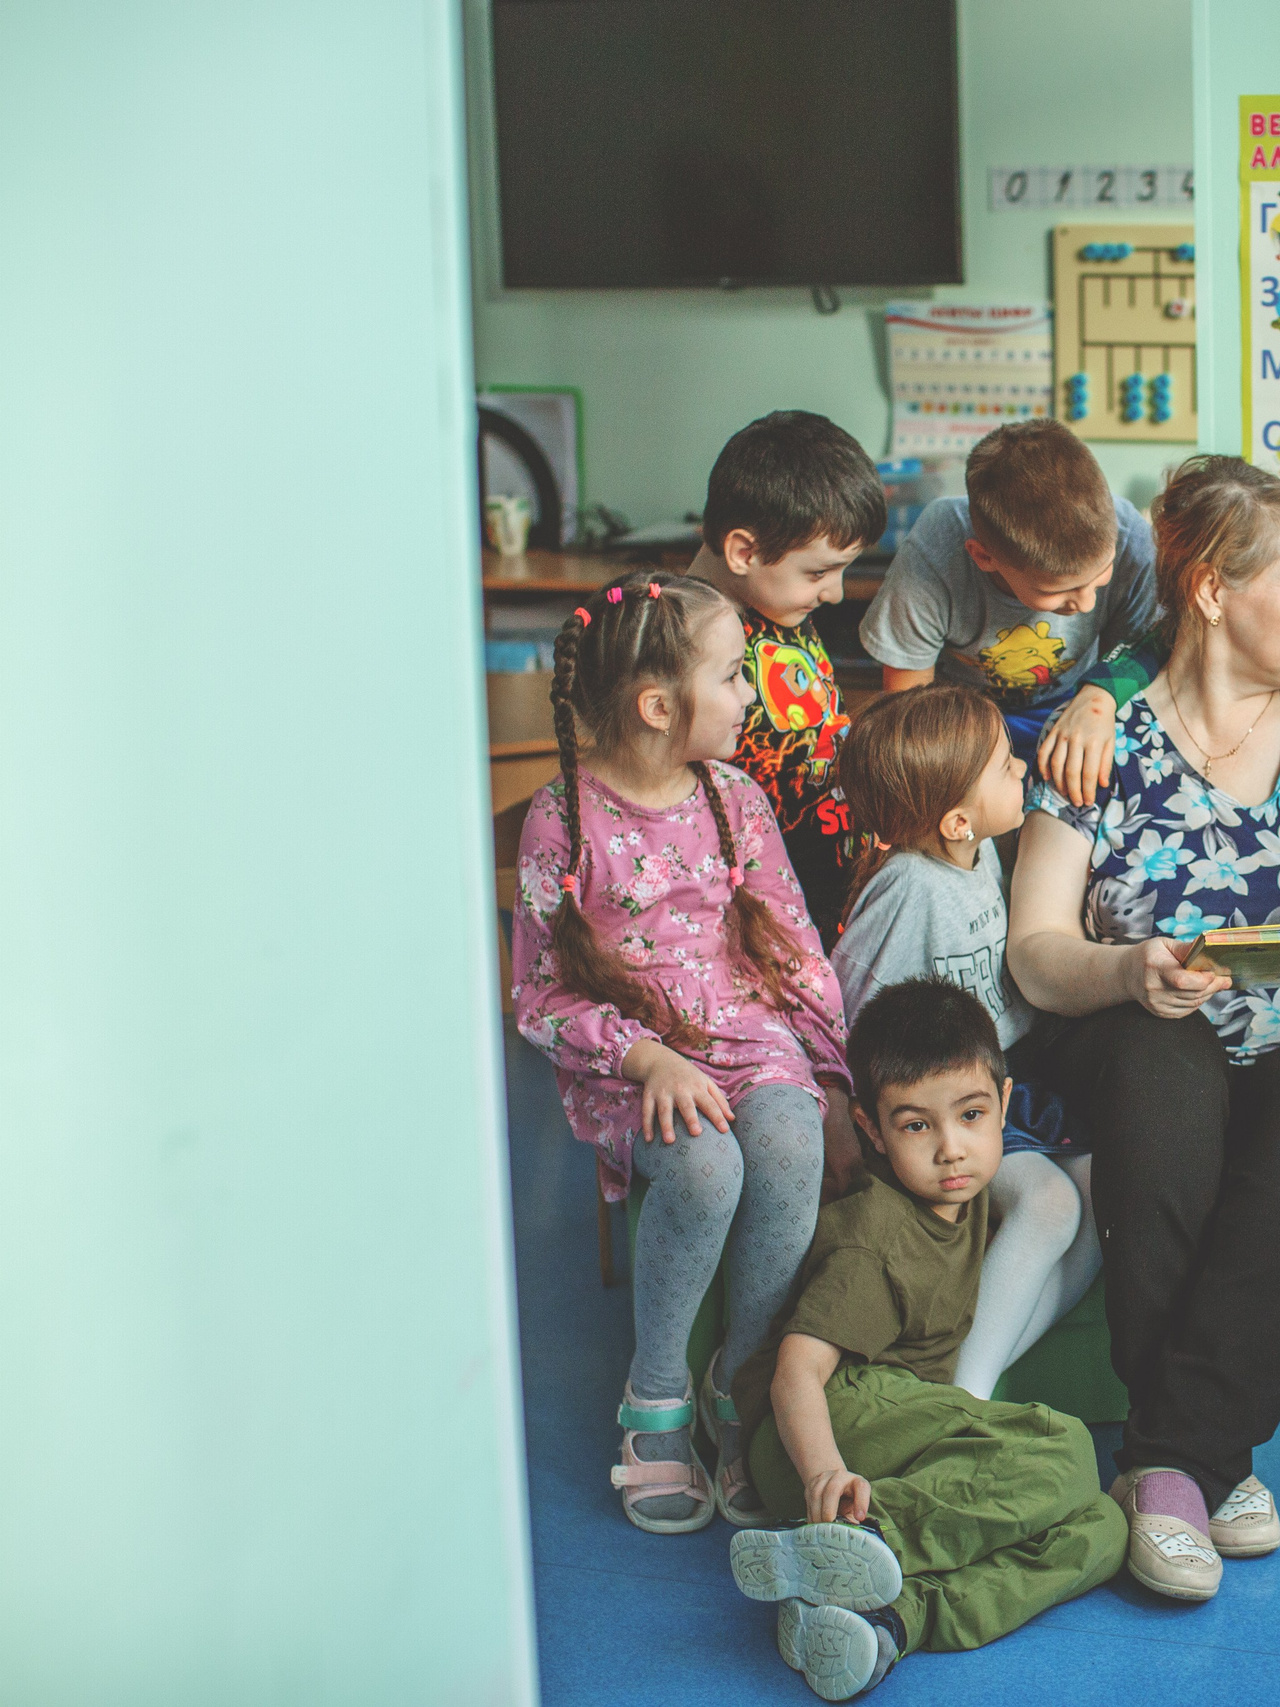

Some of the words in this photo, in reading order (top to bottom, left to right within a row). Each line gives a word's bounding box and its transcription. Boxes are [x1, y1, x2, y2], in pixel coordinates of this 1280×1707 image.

[1004, 171, 1028, 203] 0
[1054, 171, 1072, 202] 1
[1096, 171, 1117, 203] 2
[1135, 171, 1158, 203] 3
[1261, 203, 1277, 233] Г
[1261, 276, 1279, 307] З
[816, 798, 851, 835] ST
